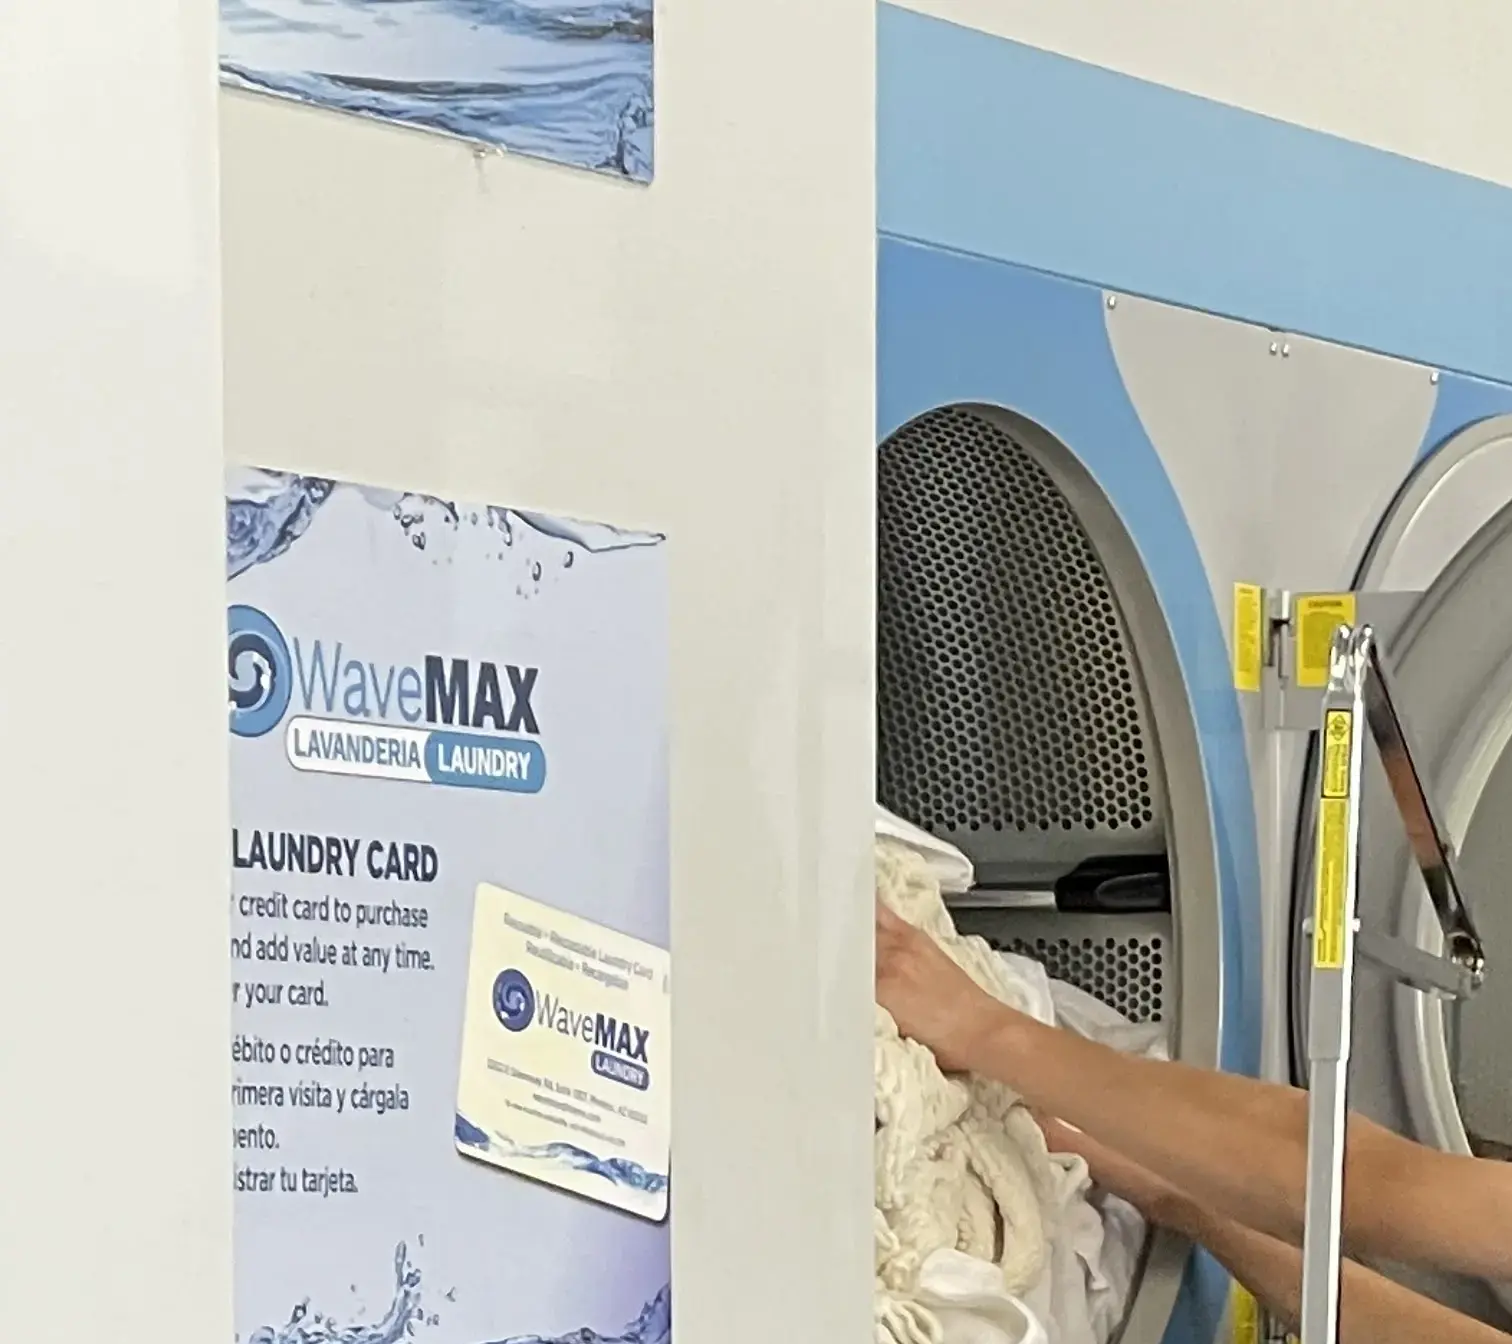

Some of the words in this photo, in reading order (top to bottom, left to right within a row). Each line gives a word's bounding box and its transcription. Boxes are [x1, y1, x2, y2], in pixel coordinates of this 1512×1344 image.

[294, 637, 540, 735] WaveMAX
[293, 728, 421, 768] LAVANDERIA
[438, 744, 532, 780] LAUNDRY
[232, 828, 359, 878] LAUNDRY
[367, 841, 438, 882] CARD
[239, 891, 288, 919] credit
[292, 895, 329, 922] card
[334, 897, 351, 923] to
[356, 899, 428, 928] purchase
[255, 933, 289, 962] add
[293, 936, 337, 965] value
[342, 940, 358, 966] at
[362, 944, 391, 973] any
[396, 941, 435, 971] time.
[245, 981, 283, 1008] your
[288, 980, 329, 1007] card.
[536, 989, 650, 1063] WaveMAX
[280, 1043, 292, 1064] o
[296, 1037, 354, 1067] crédito
[358, 1047, 395, 1071] para
[595, 1053, 645, 1085] LAUNDRY
[289, 1080, 333, 1108] visita
[336, 1087, 346, 1113] y
[351, 1082, 409, 1115] cárgala
[280, 1166, 297, 1192] tu
[302, 1166, 358, 1198] tarjeta.
